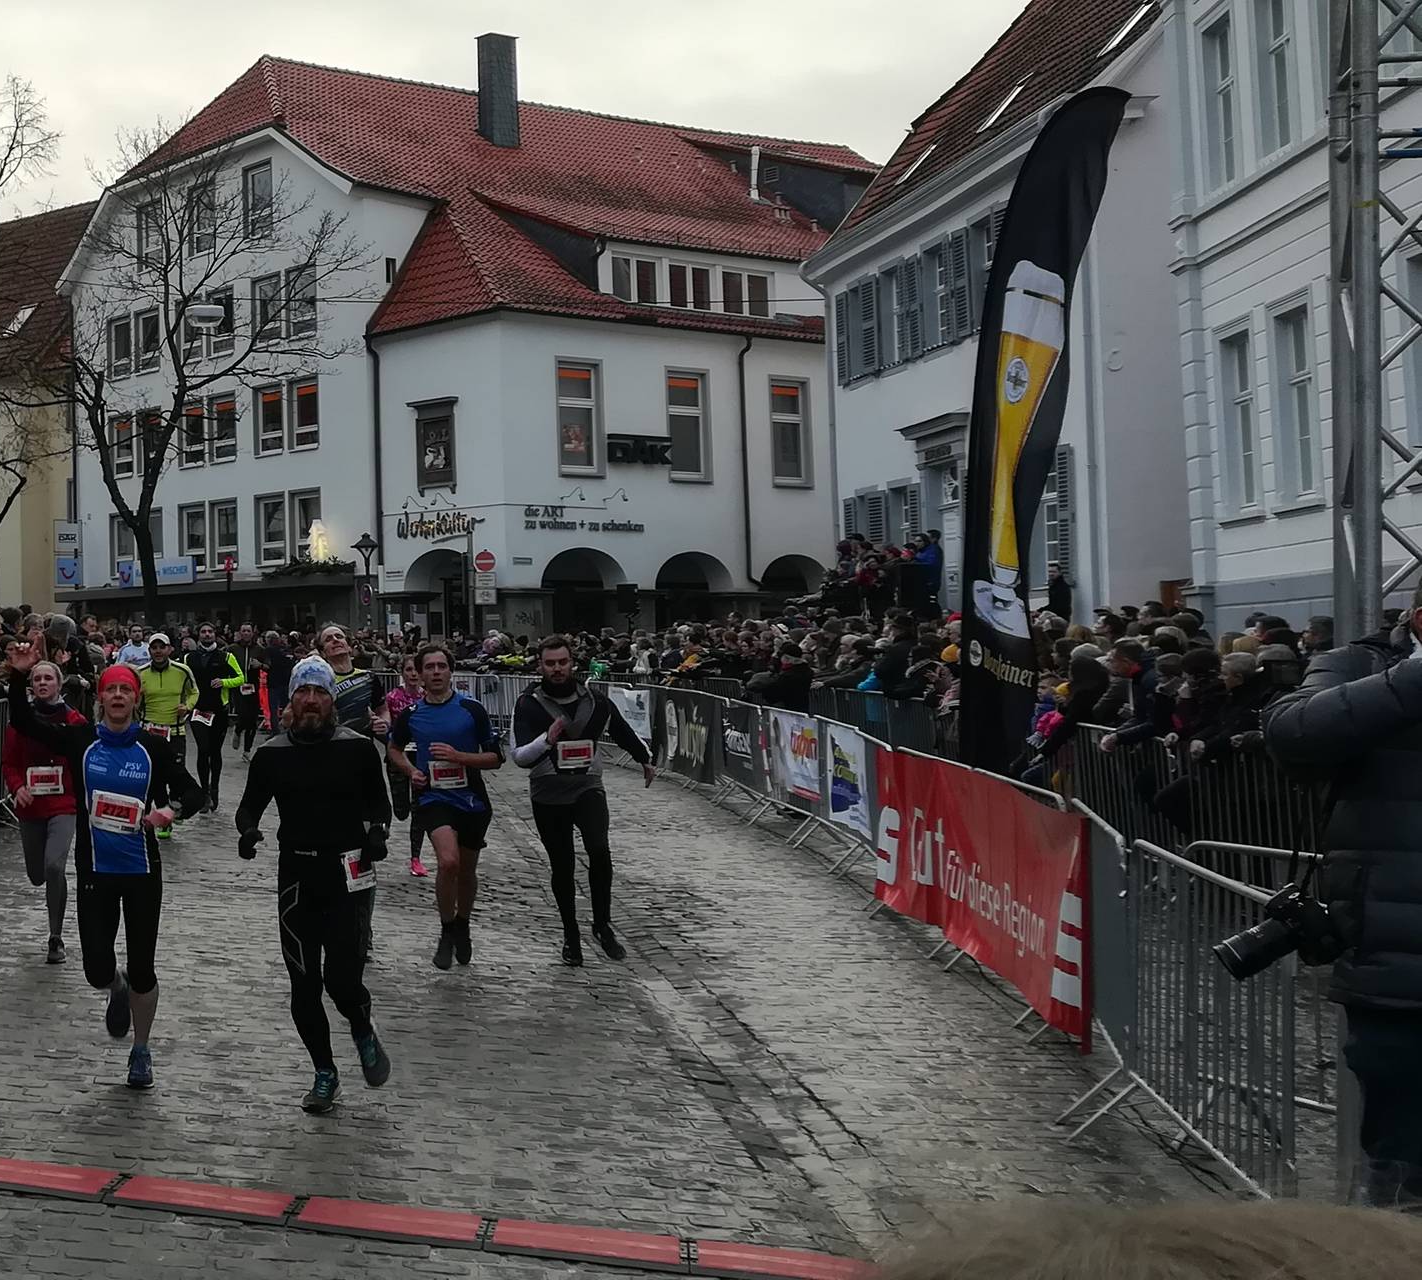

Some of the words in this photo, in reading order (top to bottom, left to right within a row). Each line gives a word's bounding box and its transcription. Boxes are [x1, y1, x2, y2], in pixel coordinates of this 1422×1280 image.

[608, 439, 673, 465] DAK
[524, 505, 540, 517] die
[542, 505, 566, 517] ART
[524, 519, 536, 530] zu
[539, 518, 577, 530] wohnen
[589, 521, 600, 532] zu
[601, 520, 645, 532] schenken
[58, 533, 77, 543] DAK
[125, 761, 143, 771] PSV
[967, 861, 1001, 926] diese
